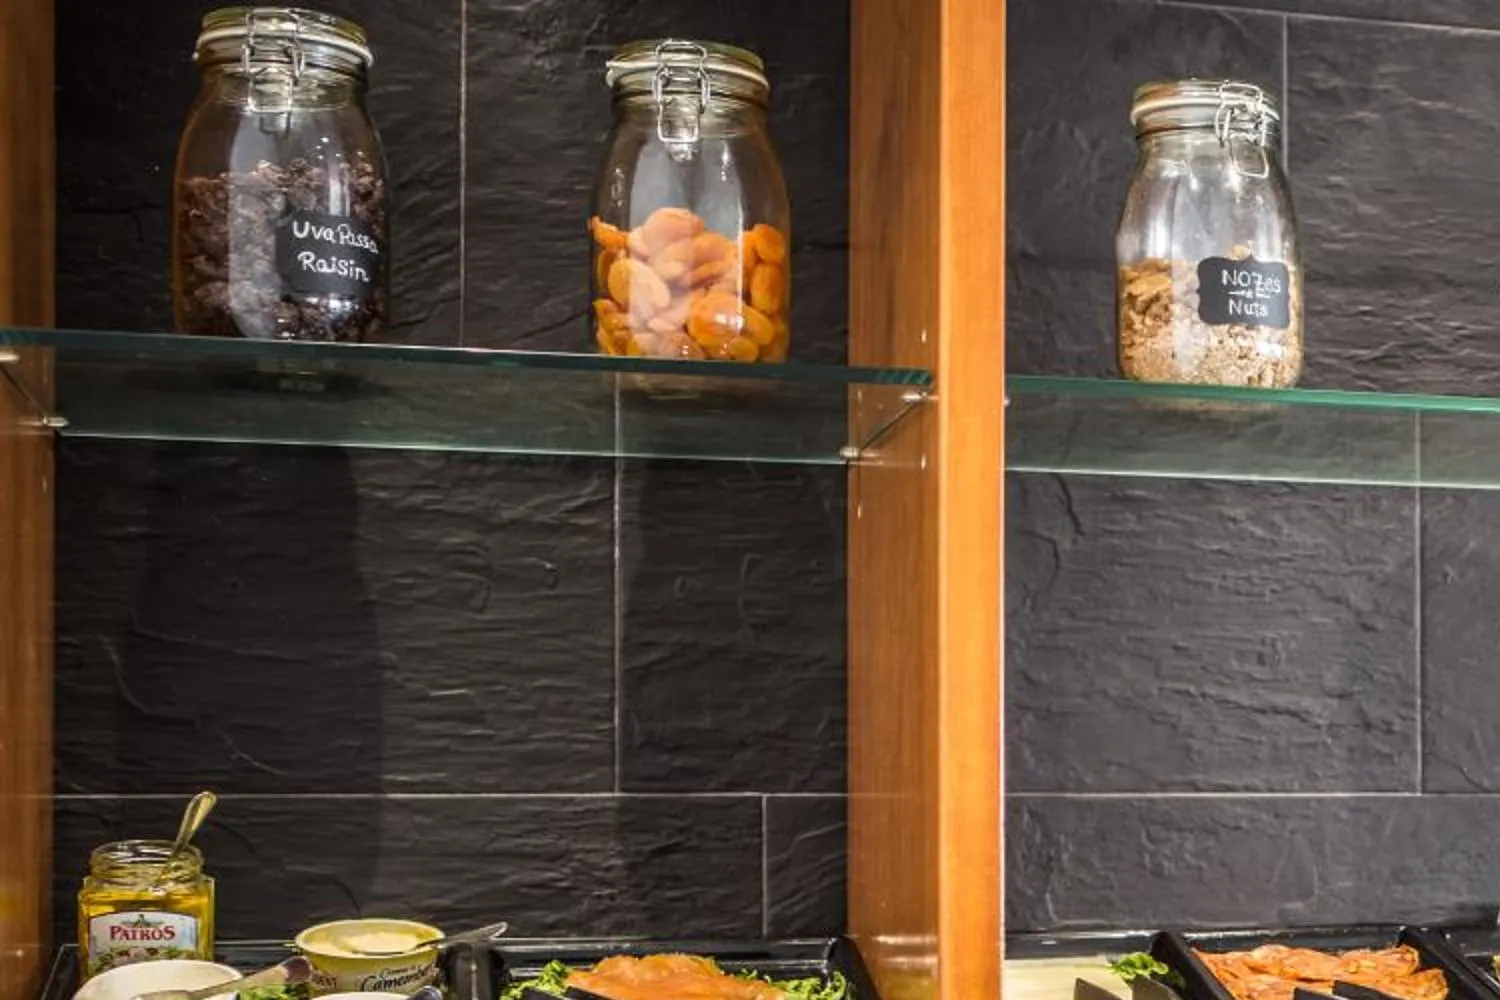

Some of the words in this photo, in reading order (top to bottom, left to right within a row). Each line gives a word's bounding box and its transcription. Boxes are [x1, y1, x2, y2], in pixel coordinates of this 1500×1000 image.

[293, 220, 336, 244] Uva
[297, 251, 370, 283] Raisin
[1228, 298, 1269, 318] Nuts
[109, 925, 176, 941] PATROS
